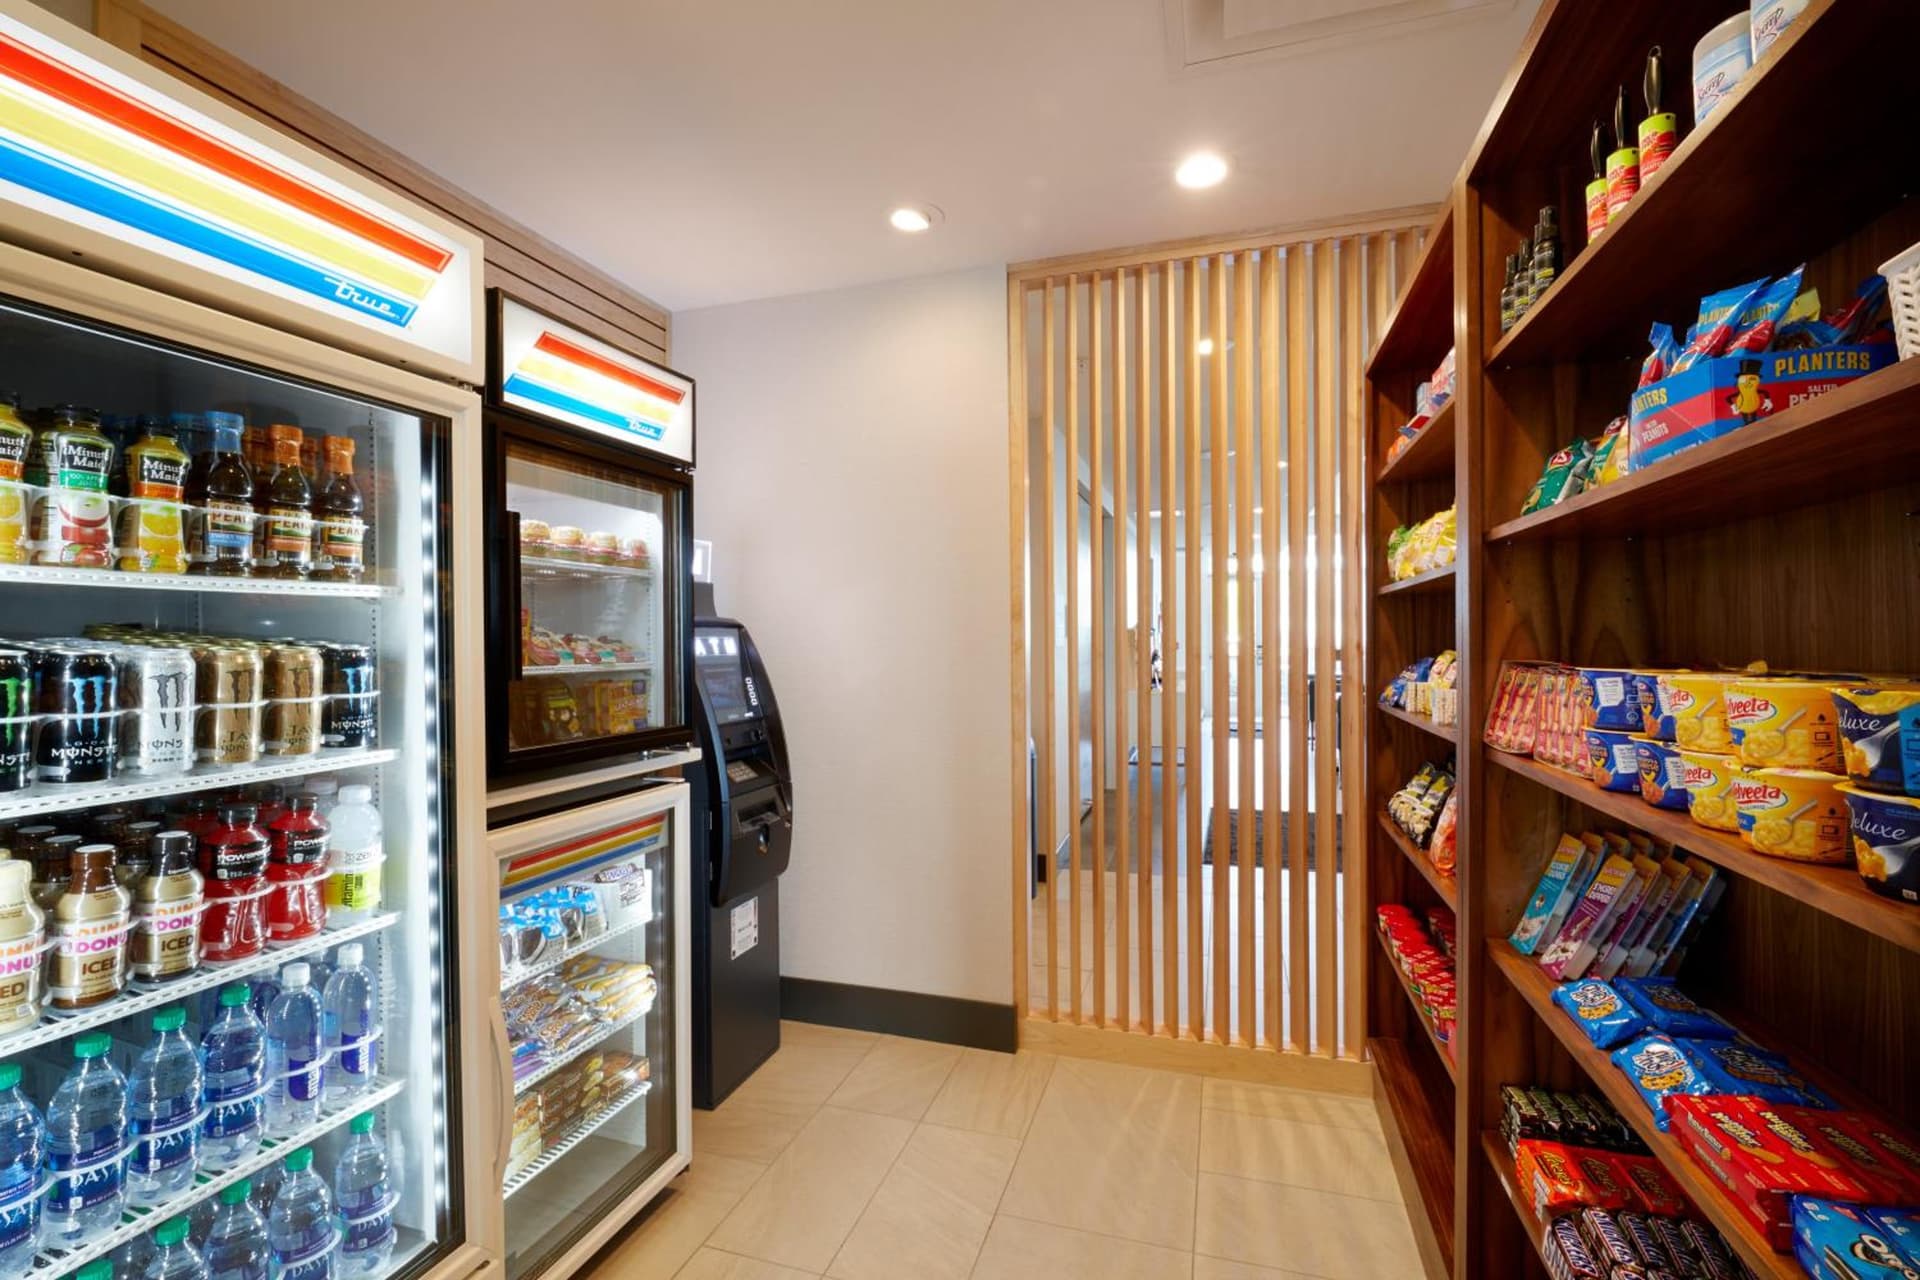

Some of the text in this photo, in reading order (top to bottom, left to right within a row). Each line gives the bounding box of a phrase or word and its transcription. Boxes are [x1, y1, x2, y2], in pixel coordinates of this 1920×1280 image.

[324, 277, 400, 319] true
[1775, 351, 1871, 377] PLANTERS
[1851, 809, 1907, 841] eluxe
[157, 914, 194, 932] DON
[161, 934, 194, 952] ICED
[82, 956, 117, 975] ICED
